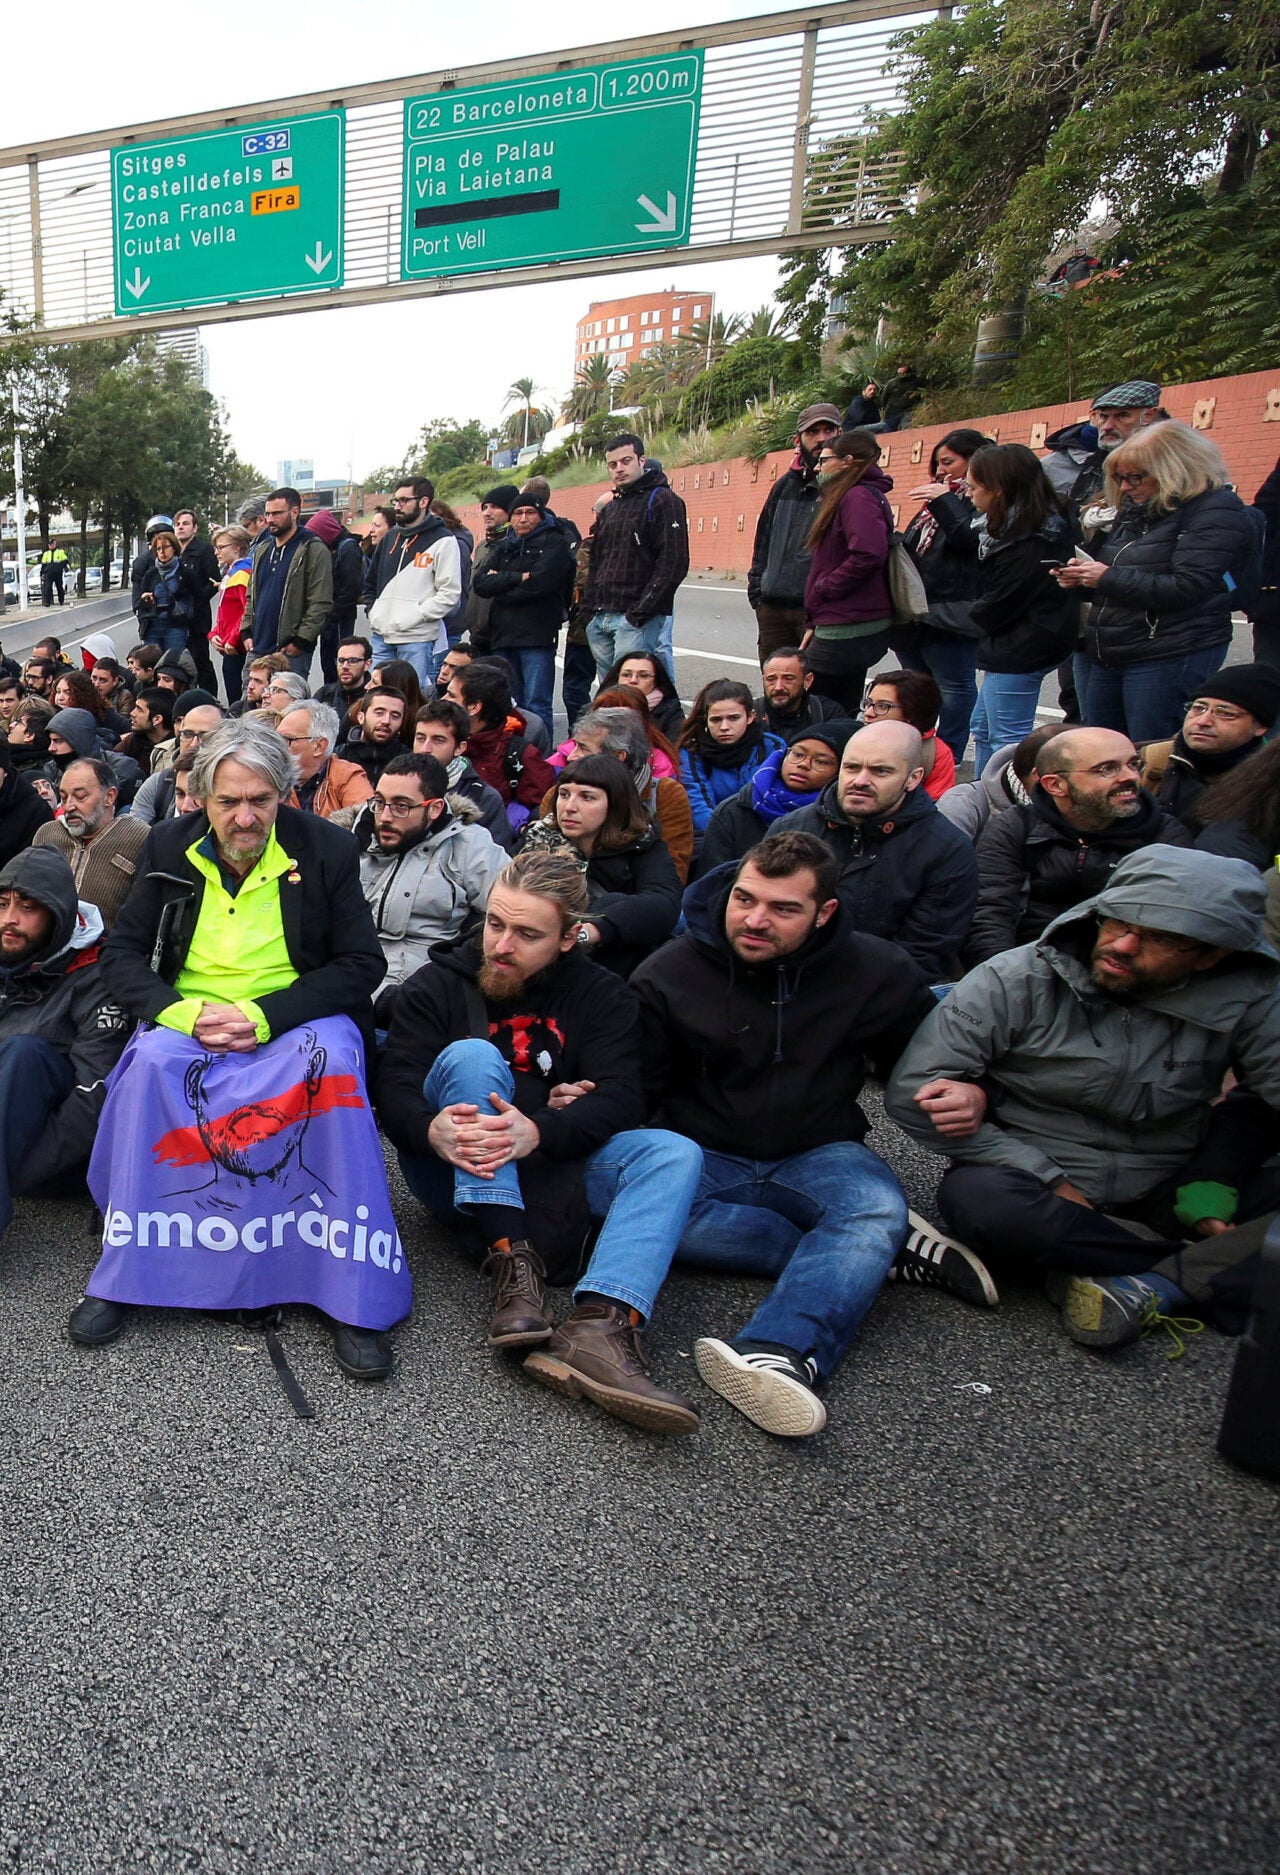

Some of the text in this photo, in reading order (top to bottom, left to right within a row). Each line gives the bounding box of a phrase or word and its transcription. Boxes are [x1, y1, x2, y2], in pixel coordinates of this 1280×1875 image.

[608, 69, 689, 98] 1.200m
[416, 86, 588, 129] 22 Barceloneta
[245, 132, 287, 154] C-32
[415, 139, 555, 175] Pla de Palau
[122, 152, 187, 177] Sitges
[123, 166, 263, 203] Castelldefels
[416, 164, 553, 199] Via Laietana
[124, 198, 245, 231] Zona Franca
[255, 192, 296, 211] Fira
[124, 226, 237, 257] Ciutat Vella
[412, 229, 486, 257] Port Vell
